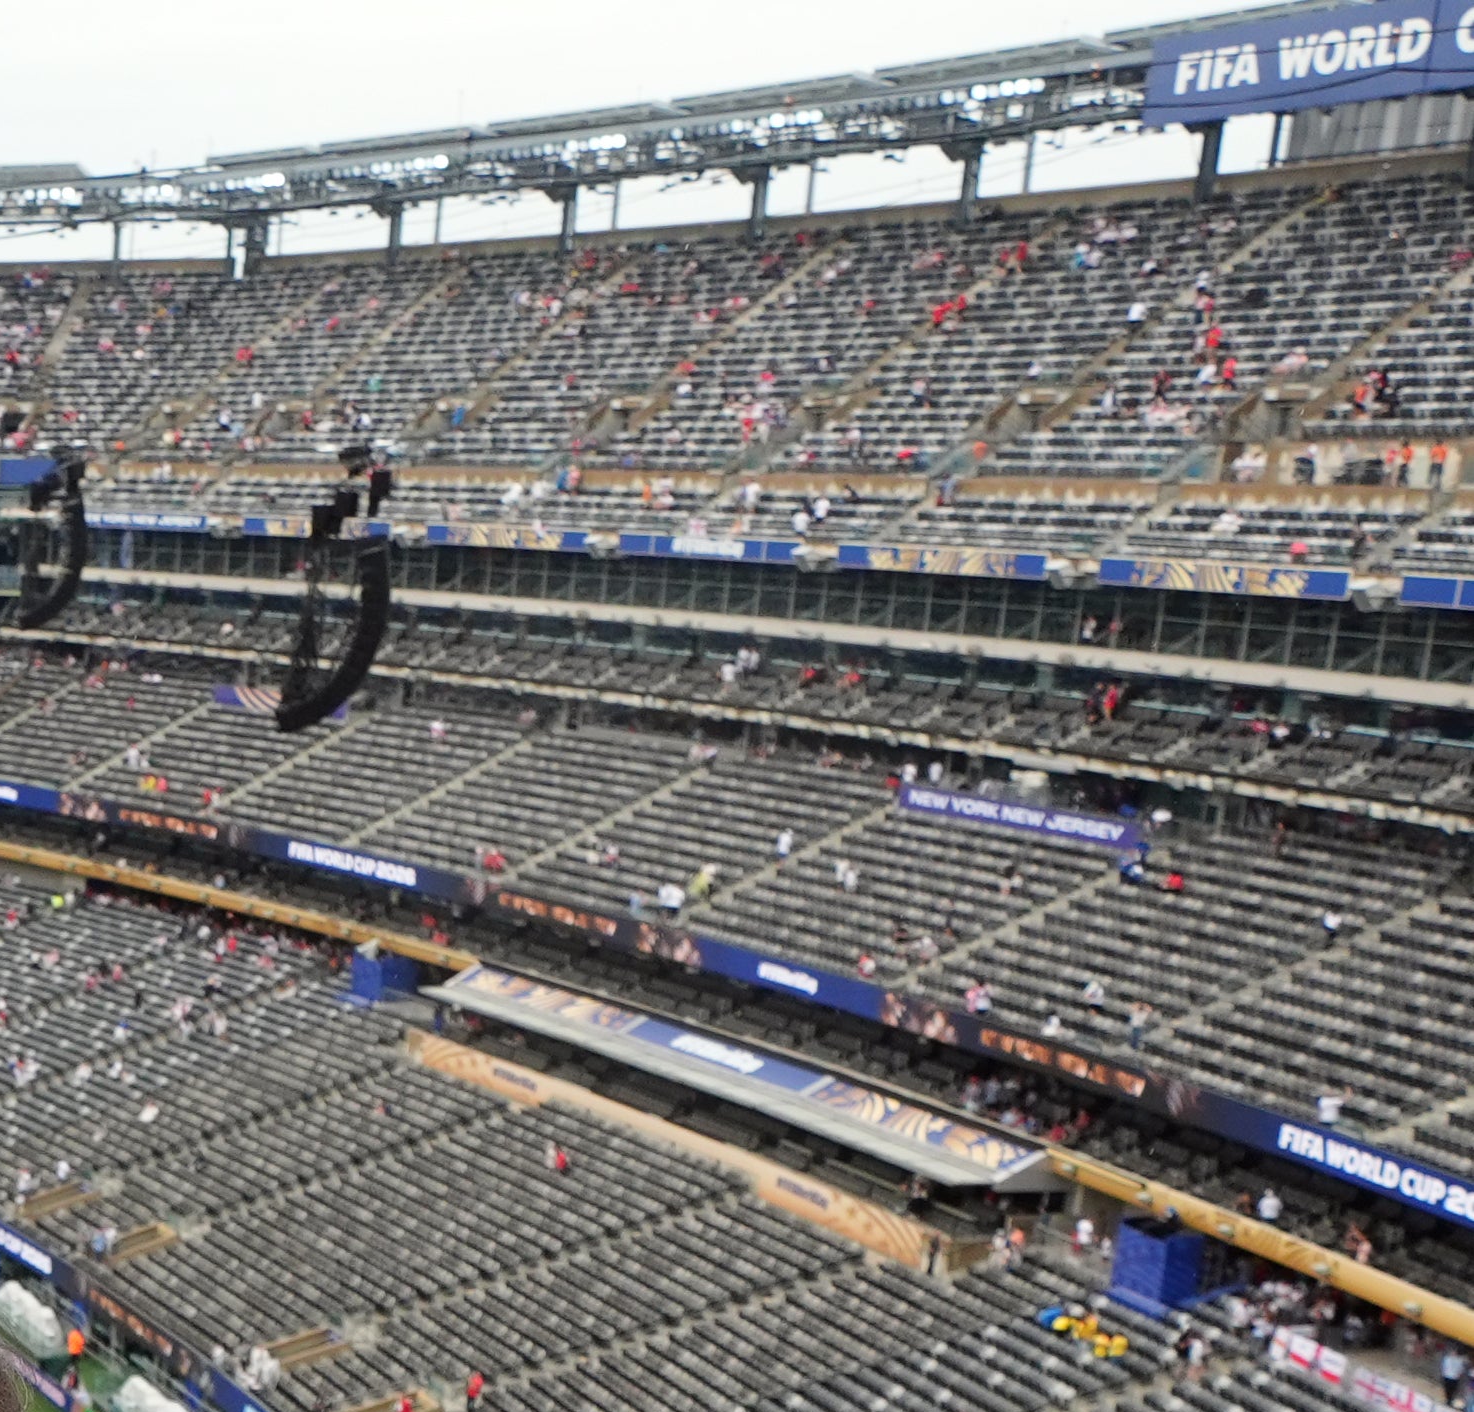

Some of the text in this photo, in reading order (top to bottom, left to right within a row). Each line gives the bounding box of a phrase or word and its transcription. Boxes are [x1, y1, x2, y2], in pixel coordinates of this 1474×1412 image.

[1173, 43, 1260, 95] FIFA
[1278, 17, 1433, 81] WORLD
[908, 789, 1125, 841] NEW YORK NEW JERSEY
[287, 841, 417, 887] FIFA WORLD CUP 2026
[1278, 1123, 1325, 1164] FIFA
[1326, 1139, 1401, 1190] WORLD
[1400, 1168, 1447, 1206] CUP
